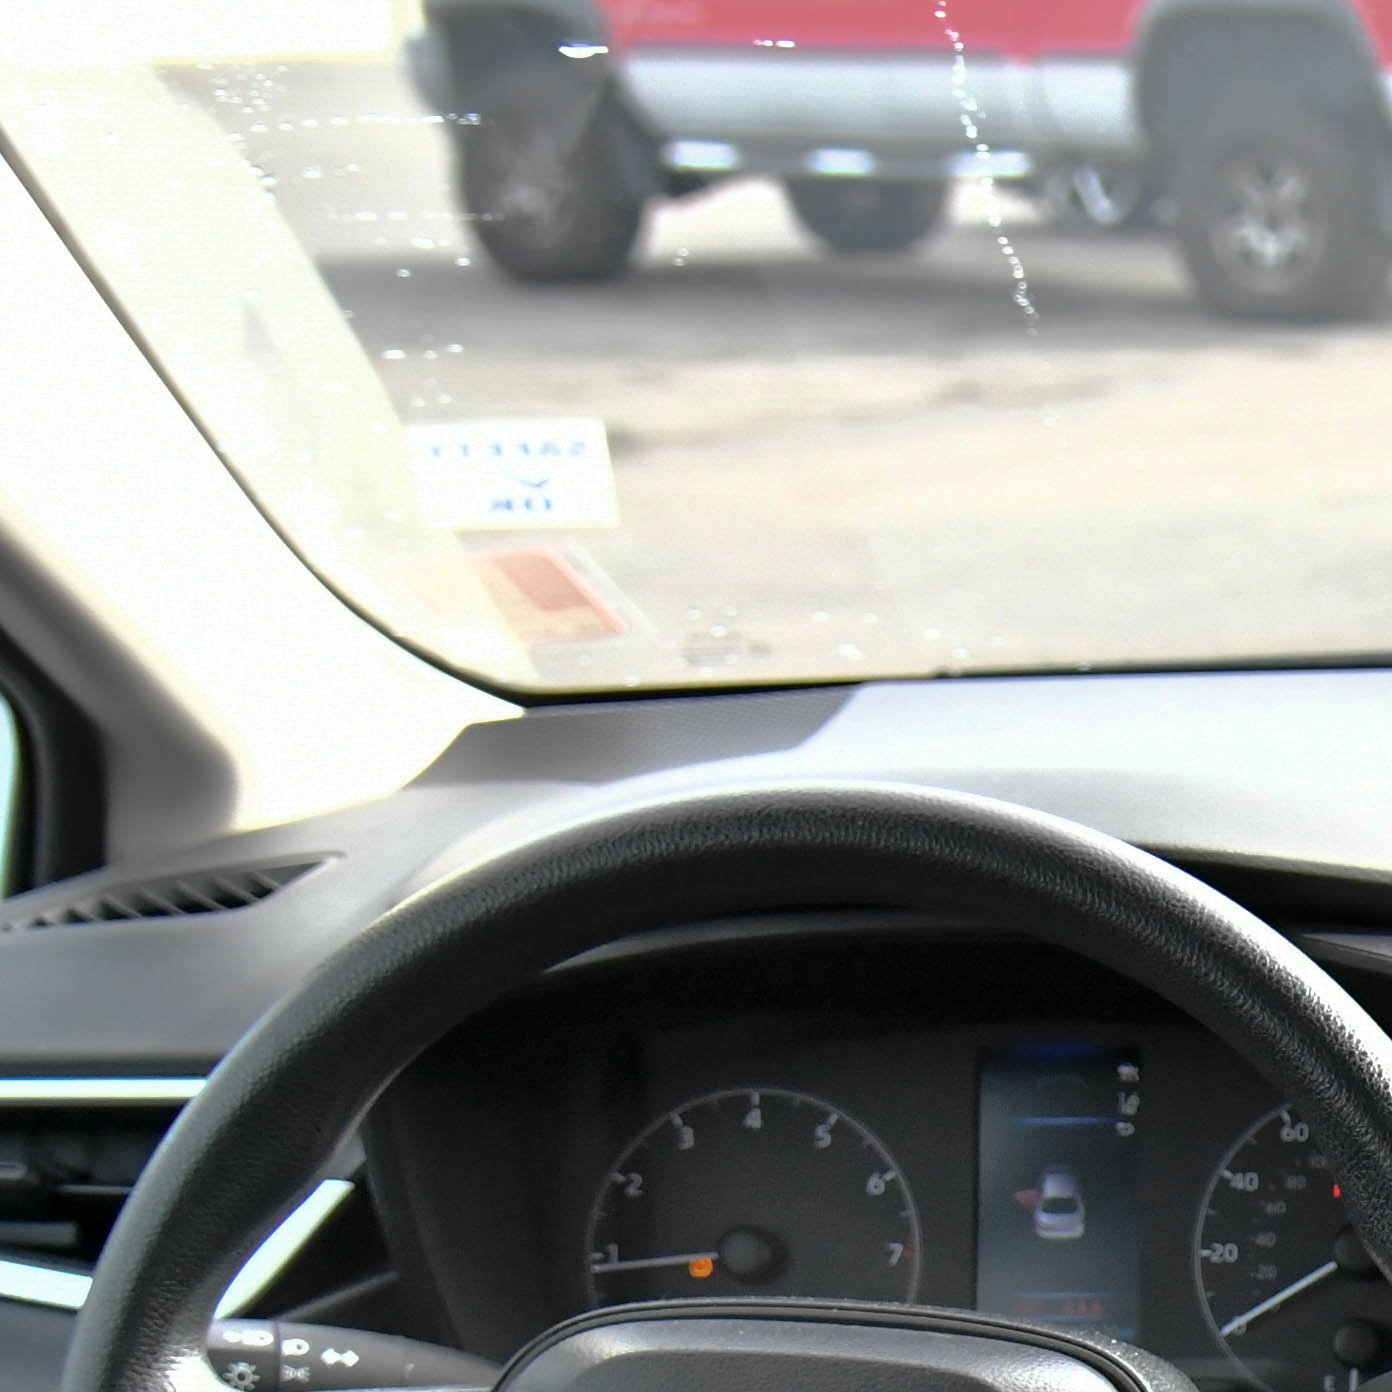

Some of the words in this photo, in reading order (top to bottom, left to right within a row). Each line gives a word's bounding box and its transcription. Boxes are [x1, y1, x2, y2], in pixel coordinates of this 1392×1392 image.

[743, 1108, 763, 1130] 4
[679, 1126, 695, 1150] 3
[814, 1125, 832, 1149] 5
[1280, 1123, 1310, 1143] 60
[625, 1173, 644, 1197] 2
[866, 1172, 886, 1195] 6
[1230, 1171, 1259, 1192] 40
[607, 1243, 619, 1262] 1
[887, 1242, 904, 1266] 7
[1209, 1244, 1239, 1263] 20
[1323, 1375, 1336, 1392] E
